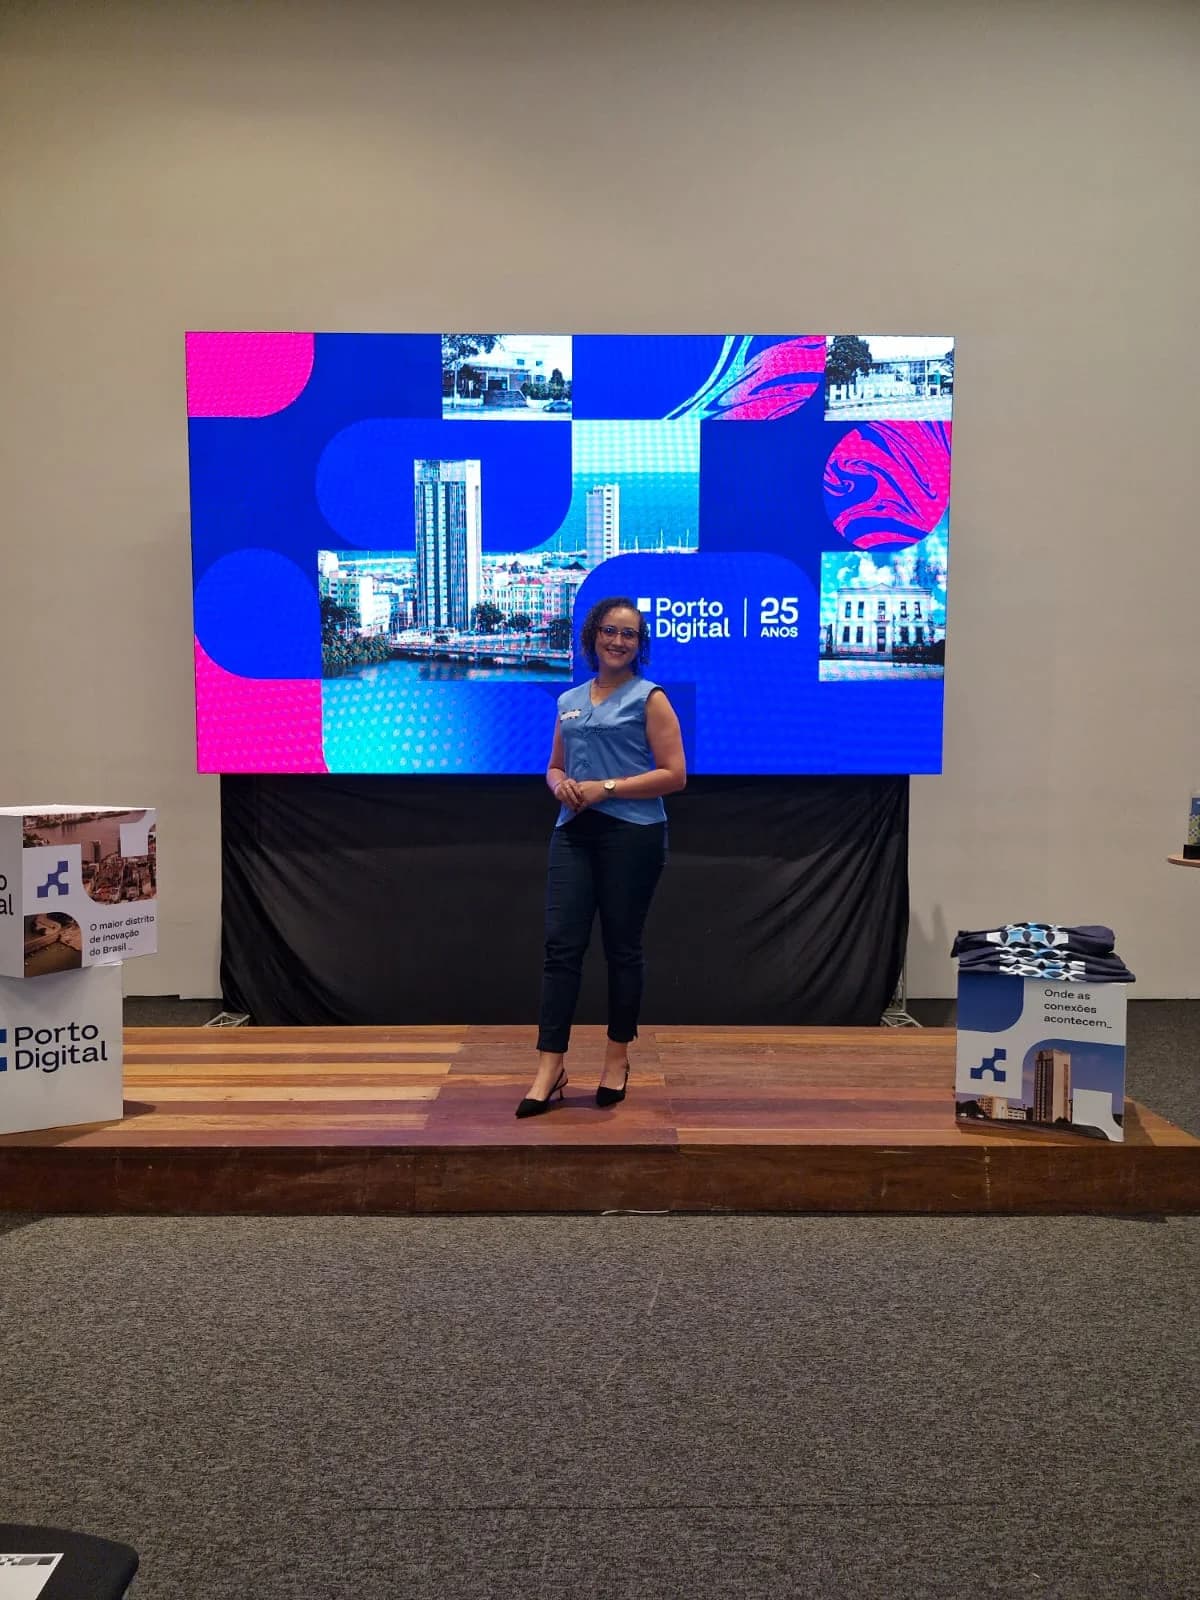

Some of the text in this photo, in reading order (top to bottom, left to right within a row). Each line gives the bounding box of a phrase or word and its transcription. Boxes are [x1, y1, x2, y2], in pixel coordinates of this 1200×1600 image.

[656, 597, 723, 617] Porto
[760, 597, 799, 624] 25
[656, 617, 730, 643] Digital
[760, 627, 798, 637] ANOS
[90, 915, 155, 931] O maior distrito
[89, 929, 140, 944] de inovação
[89, 947, 101, 956] do
[1044, 989, 1091, 1000] Onde as
[1044, 1002, 1097, 1013] conexões
[15, 1022, 98, 1047] Porto
[15, 1040, 108, 1073] Digital
